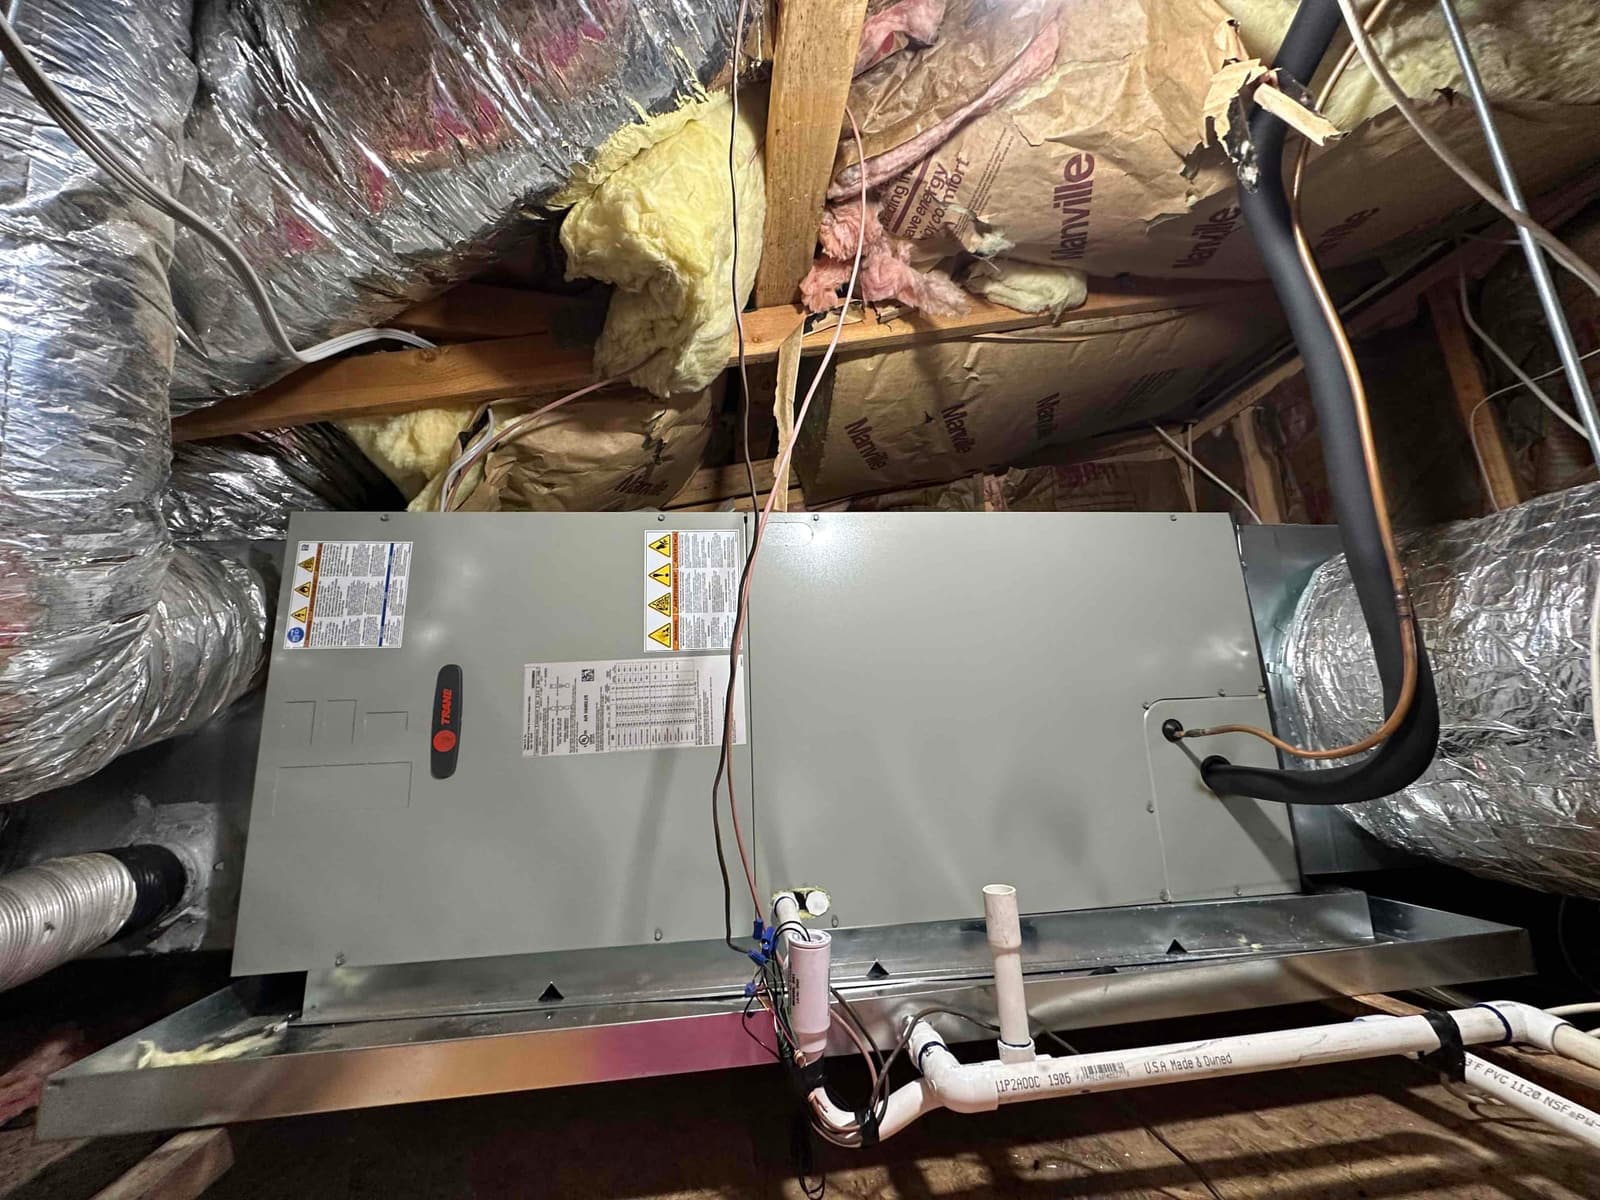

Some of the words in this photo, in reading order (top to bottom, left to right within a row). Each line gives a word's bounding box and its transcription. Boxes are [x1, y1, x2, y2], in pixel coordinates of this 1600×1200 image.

[916, 162, 948, 216] energy
[1052, 152, 1096, 260] Manville
[441, 688, 453, 726] TRANE
[1048, 1072, 1072, 1087] 1906
[1170, 1059, 1194, 1071] Made
[1196, 1056, 1203, 1068] &
[1204, 1053, 1233, 1066] Owned
[1484, 1067, 1509, 1085] PVC
[1510, 1081, 1542, 1100] 1120
